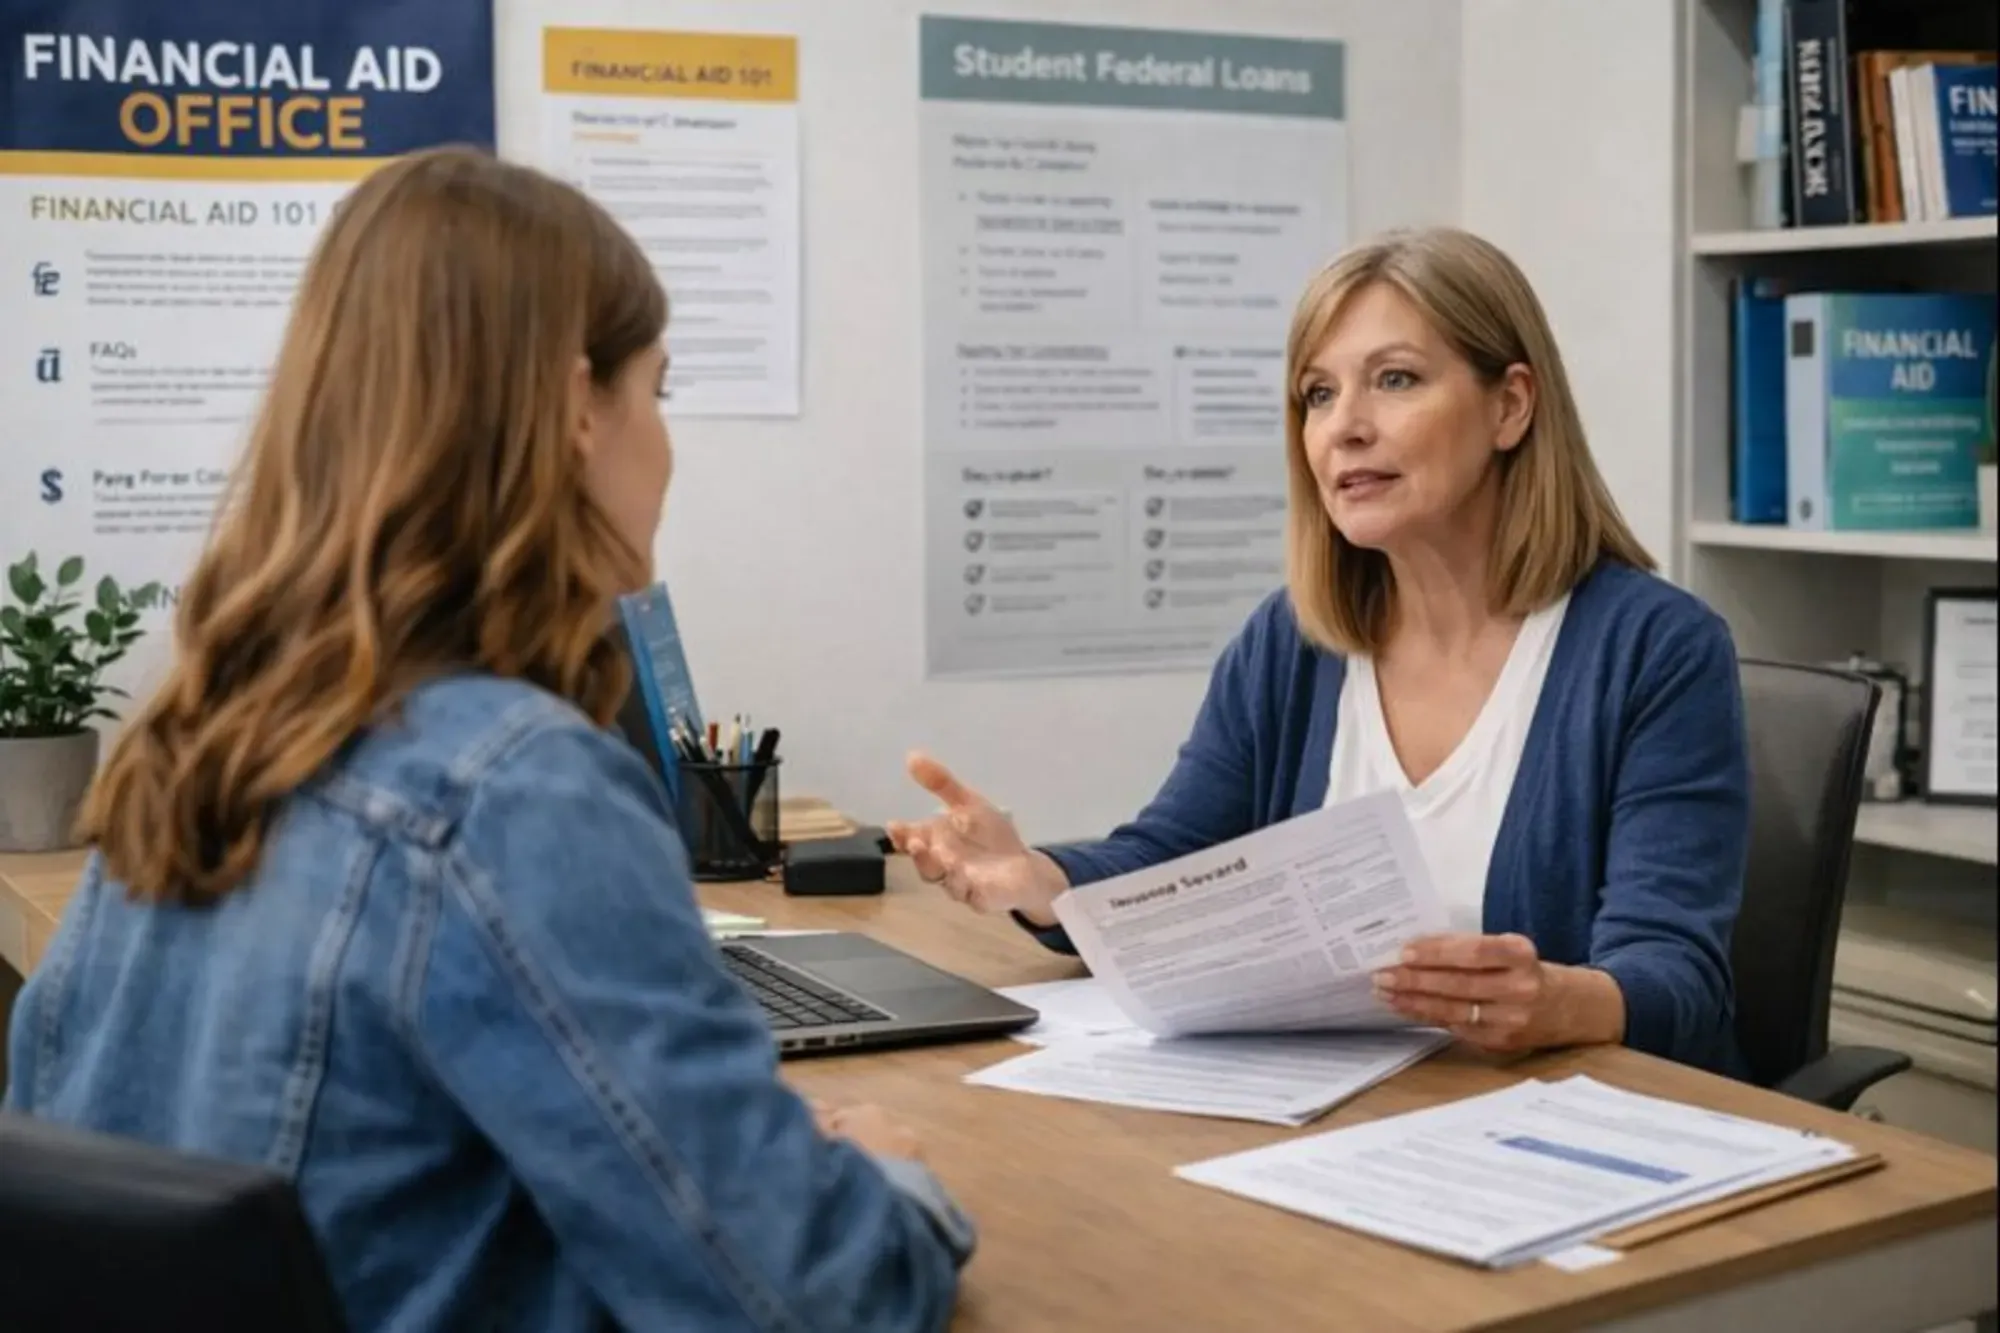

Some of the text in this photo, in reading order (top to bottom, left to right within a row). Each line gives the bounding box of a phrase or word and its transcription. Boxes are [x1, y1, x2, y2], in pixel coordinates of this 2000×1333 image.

[24, 33, 442, 92] FINANCIAL AID
[571, 60, 772, 88] FINANCIAL AID 101
[953, 44, 1312, 95] Student Federal Loans
[119, 92, 365, 149] OFFICE
[31, 195, 197, 225] FINANCIAL
[206, 201, 258, 225] AID
[272, 201, 317, 226] 101
[90, 341, 137, 360] FAQs
[1843, 328, 1978, 359] FINANCIAL
[1890, 359, 1937, 391] AID
